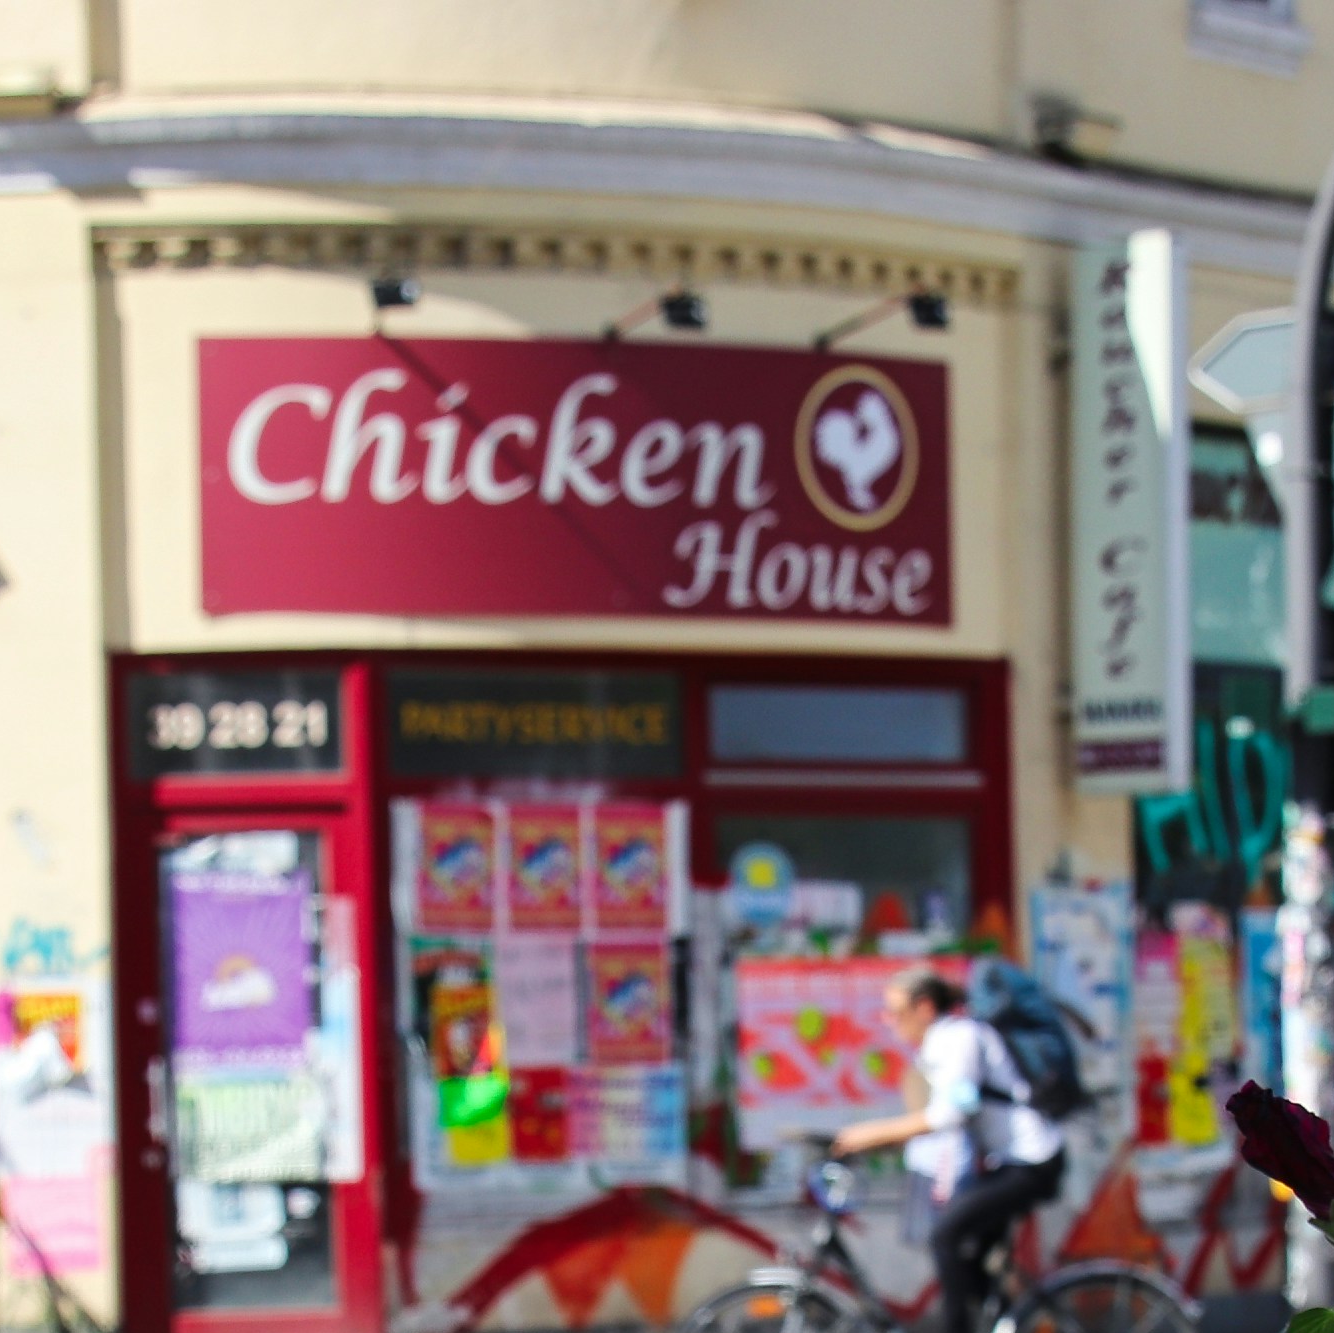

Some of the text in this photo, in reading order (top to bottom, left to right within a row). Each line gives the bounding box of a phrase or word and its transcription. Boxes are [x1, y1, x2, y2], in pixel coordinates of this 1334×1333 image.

[227, 369, 774, 507] Chicken
[662, 511, 932, 616] House
[208, 700, 268, 750] 28
[271, 700, 328, 748] 21
[399, 700, 667, 746] PARTYSERVICE
